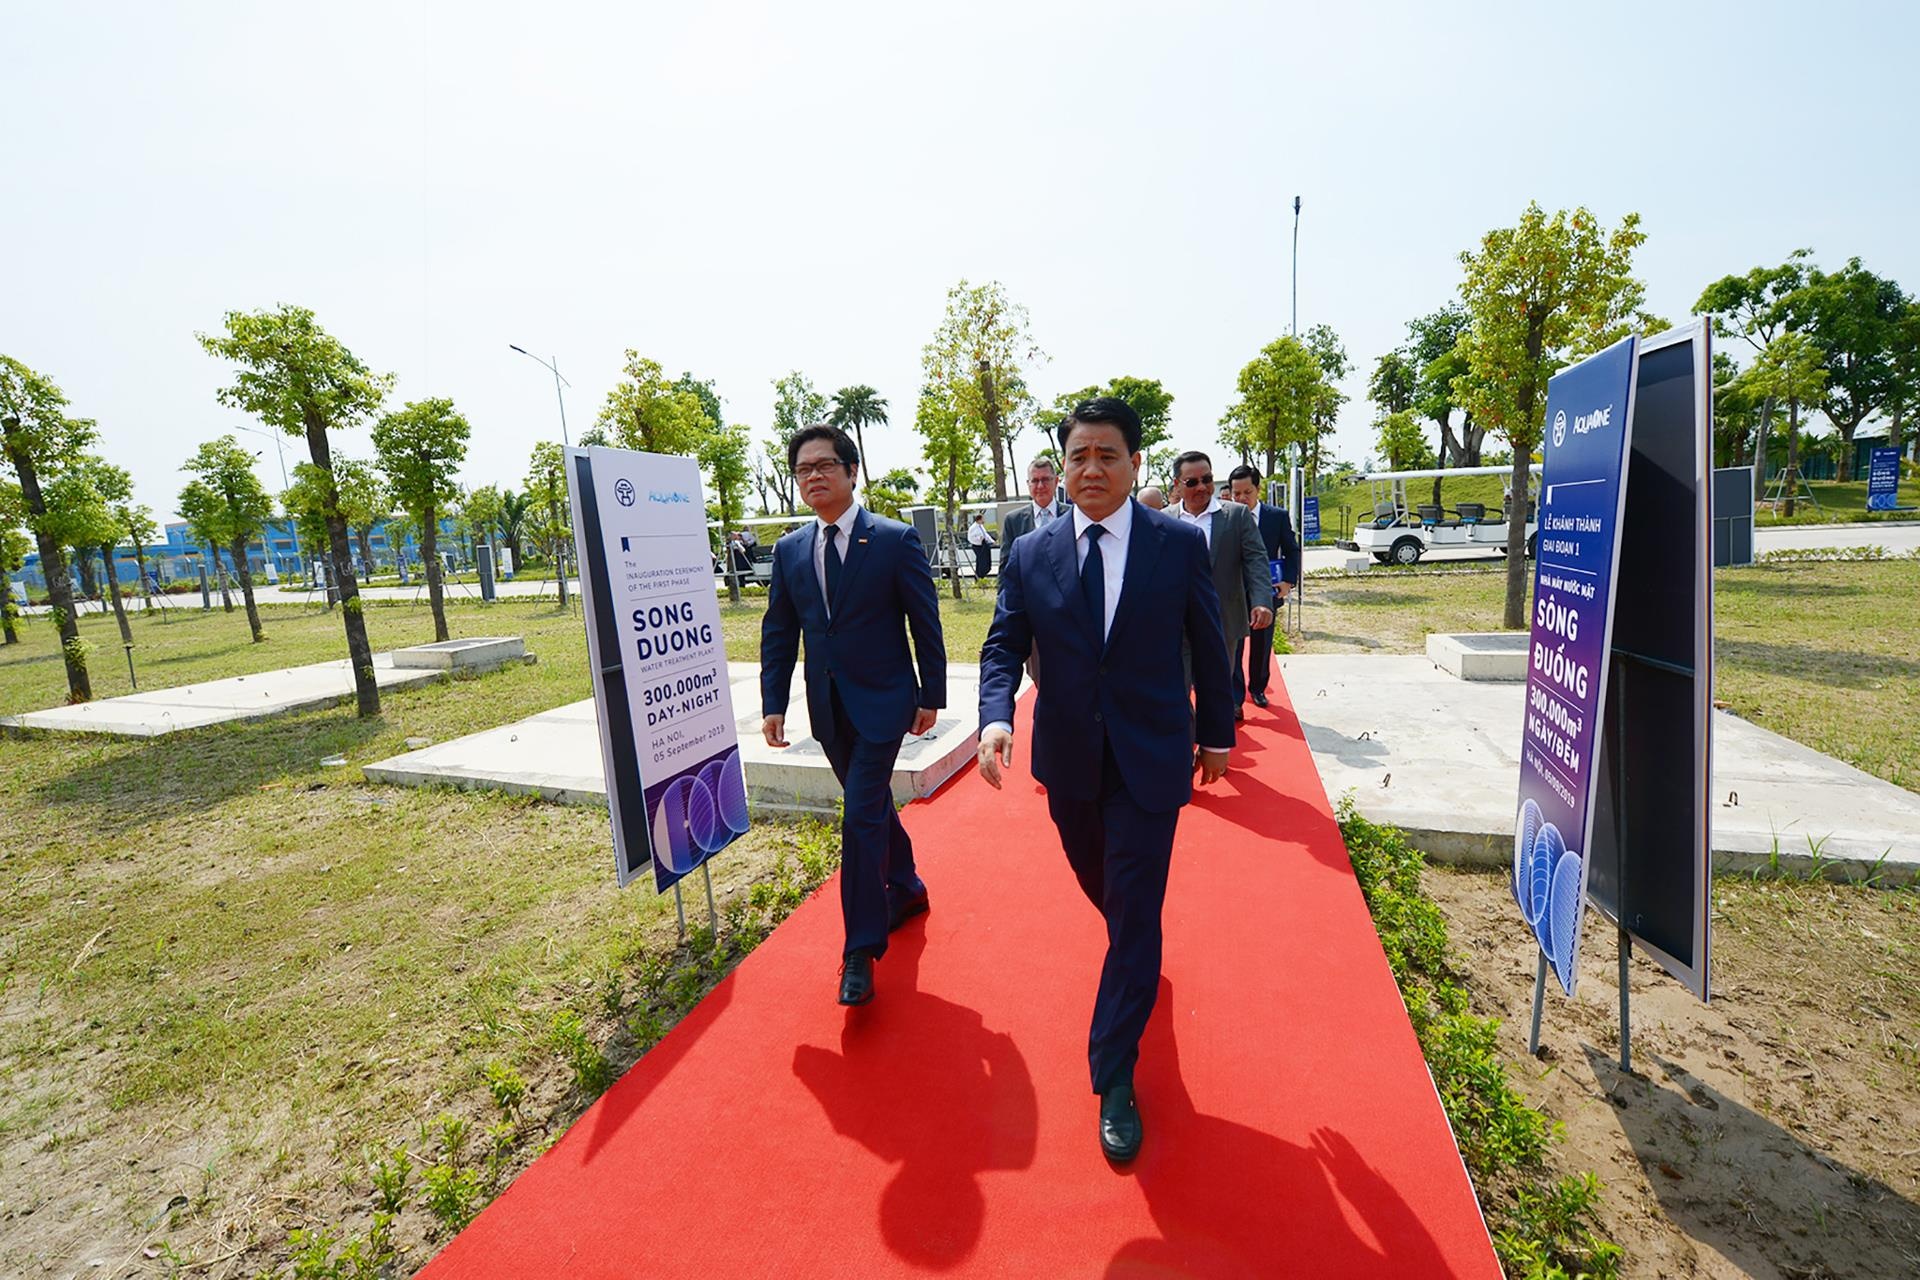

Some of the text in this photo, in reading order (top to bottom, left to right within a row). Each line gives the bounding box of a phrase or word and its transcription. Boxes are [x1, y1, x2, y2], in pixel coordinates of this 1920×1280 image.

[1552, 515, 1575, 531] KHÁNH
[1576, 515, 1601, 533] THÀNH
[1543, 539, 1580, 557] GIAI ĐOẠN 1
[626, 566, 704, 580] INAUGURATION CEREMONY
[628, 577, 690, 592] OF THE FIRST PHASE
[632, 602, 694, 632] SONG
[1536, 594, 1579, 642] SÔNG
[637, 624, 712, 660] DUONG
[640, 648, 714, 673] WATER TREATMENT PLANT
[1533, 643, 1588, 700] ĐUỐNG
[647, 688, 720, 726] DAY-NIGHT
[652, 738, 665, 750] HA
[653, 724, 725, 763] 05 September 2019
[1528, 713, 1580, 773] NGÀY/ĐÊM
